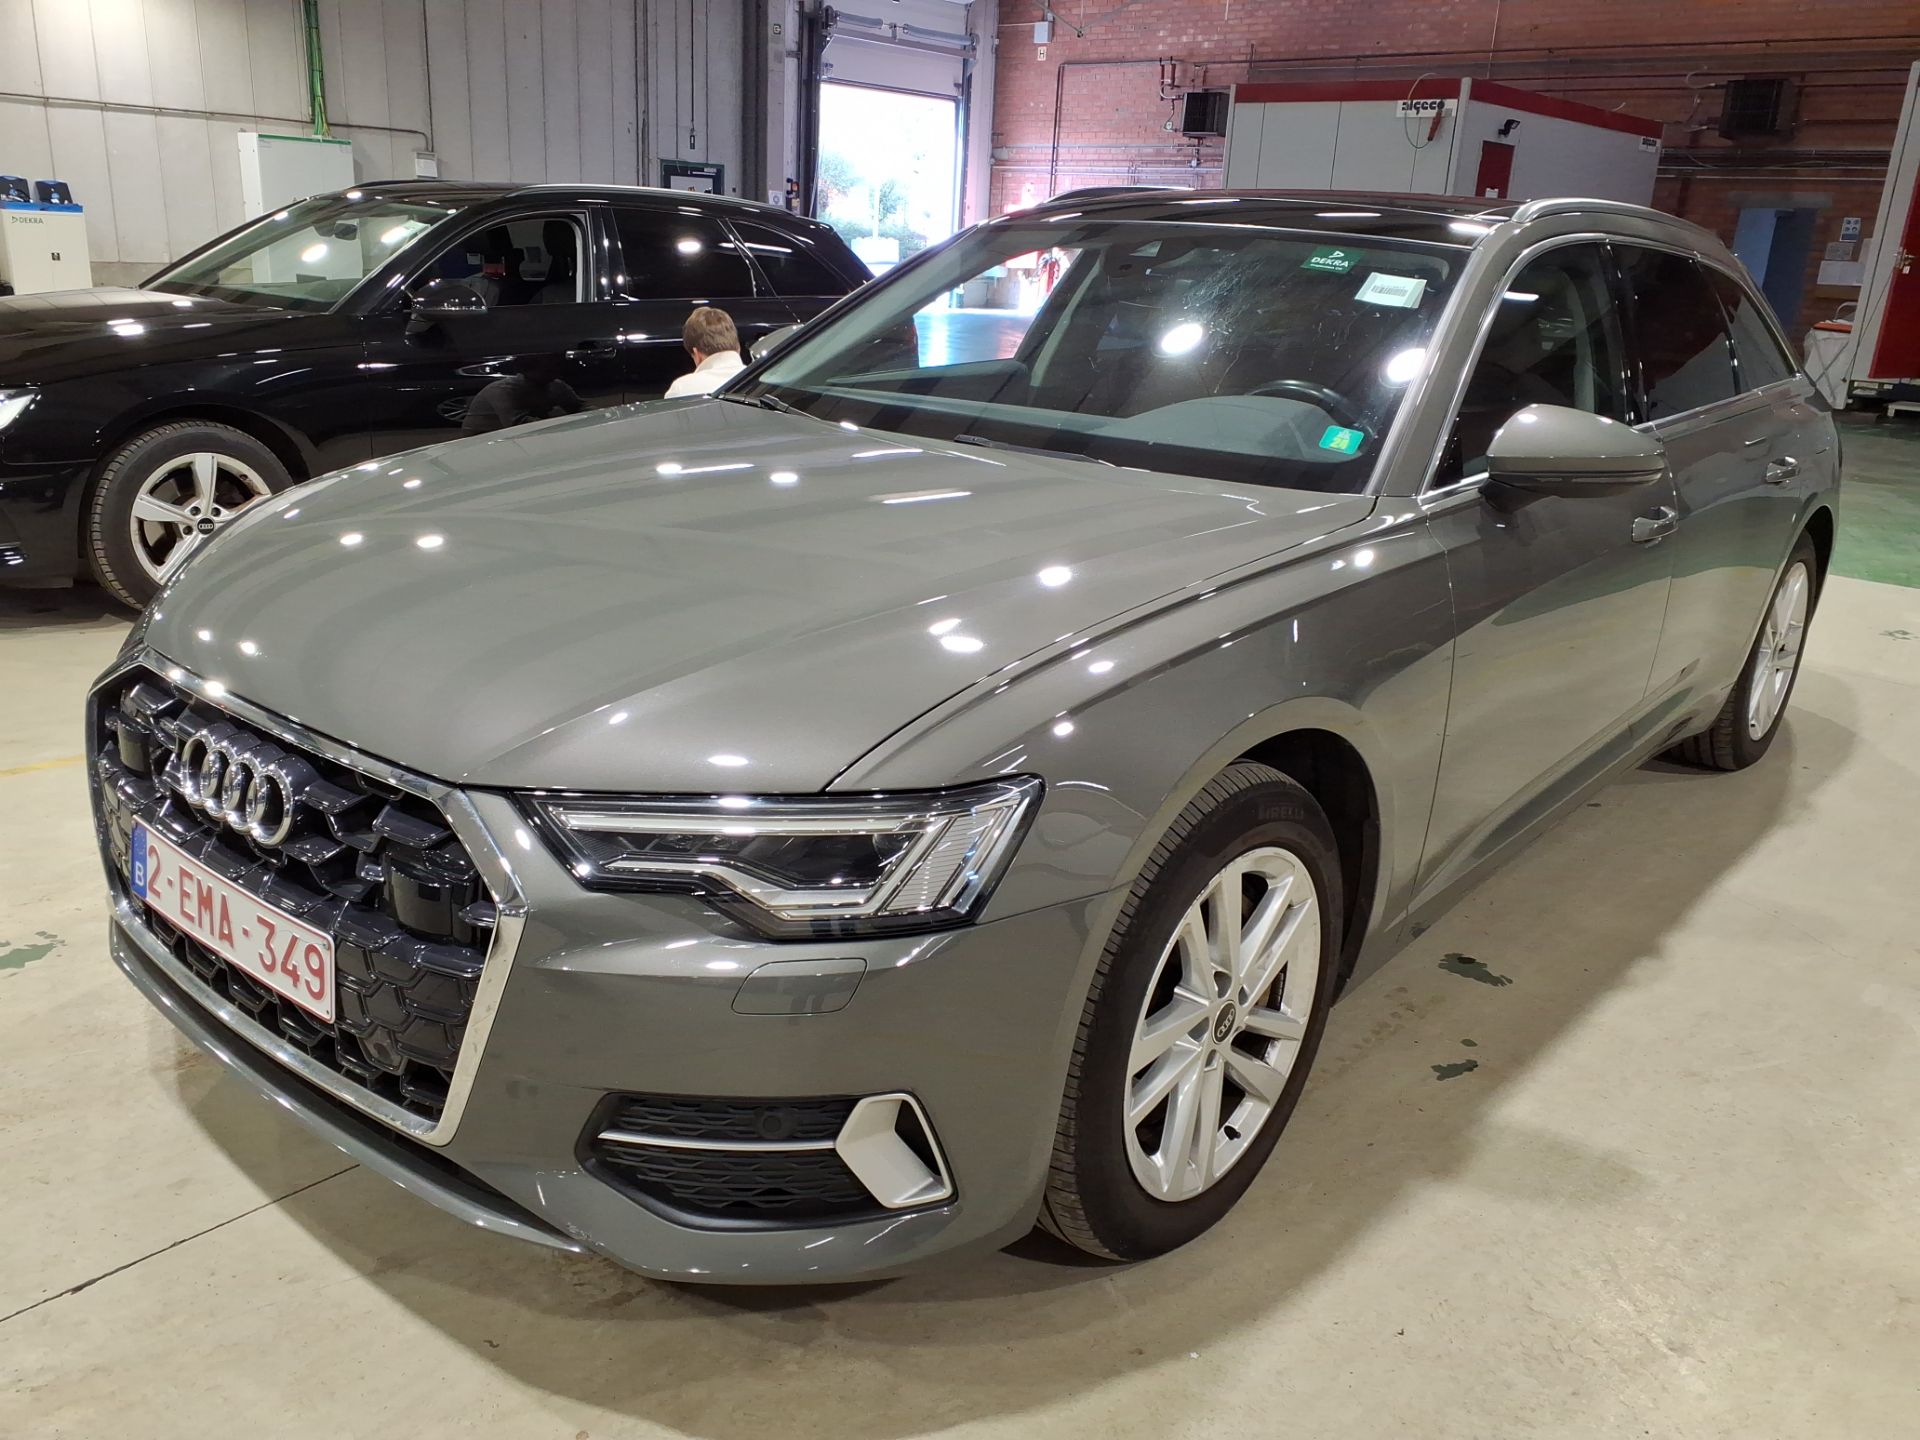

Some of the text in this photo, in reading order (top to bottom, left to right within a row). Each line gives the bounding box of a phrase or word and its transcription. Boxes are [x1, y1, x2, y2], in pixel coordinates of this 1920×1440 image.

[1311, 256, 1349, 268] DEKRA
[135, 862, 144, 886] B
[148, 845, 325, 1000] 2-EMA-349
